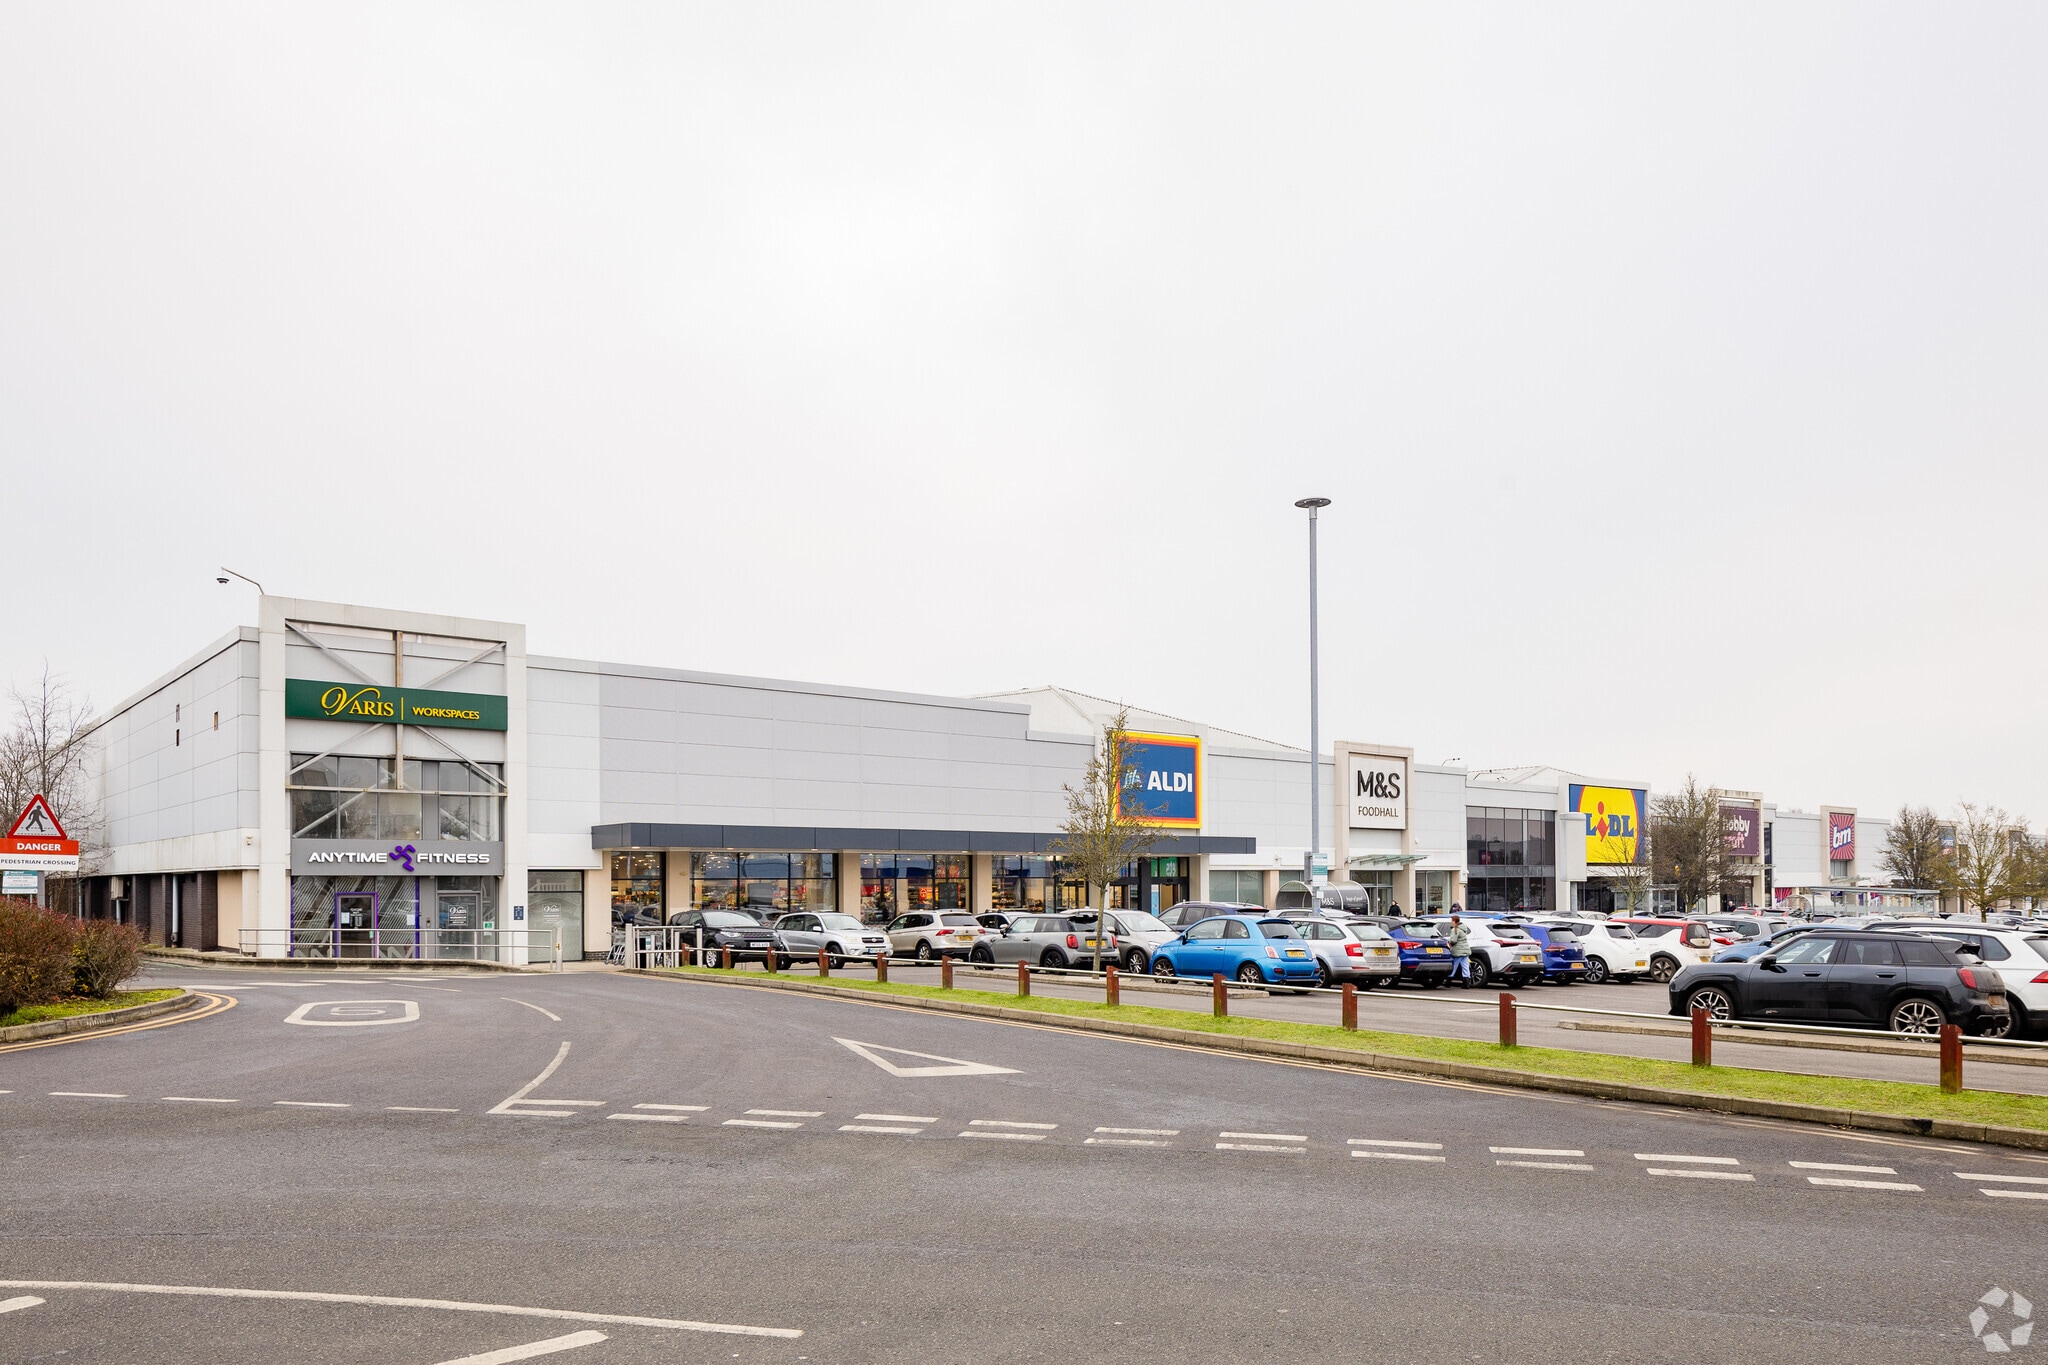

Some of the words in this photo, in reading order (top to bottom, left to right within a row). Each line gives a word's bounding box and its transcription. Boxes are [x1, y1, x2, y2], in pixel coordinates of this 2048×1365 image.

[412, 706, 481, 720] WORKSPACES
[1147, 770, 1194, 793] ALDI
[1357, 770, 1402, 799] M&S
[1358, 805, 1399, 819] FOODHALL
[16, 842, 62, 851] DANGER
[308, 852, 388, 863] ANYTIME
[416, 853, 490, 864] FITNESS
[1321, 897, 1335, 906] M&S
